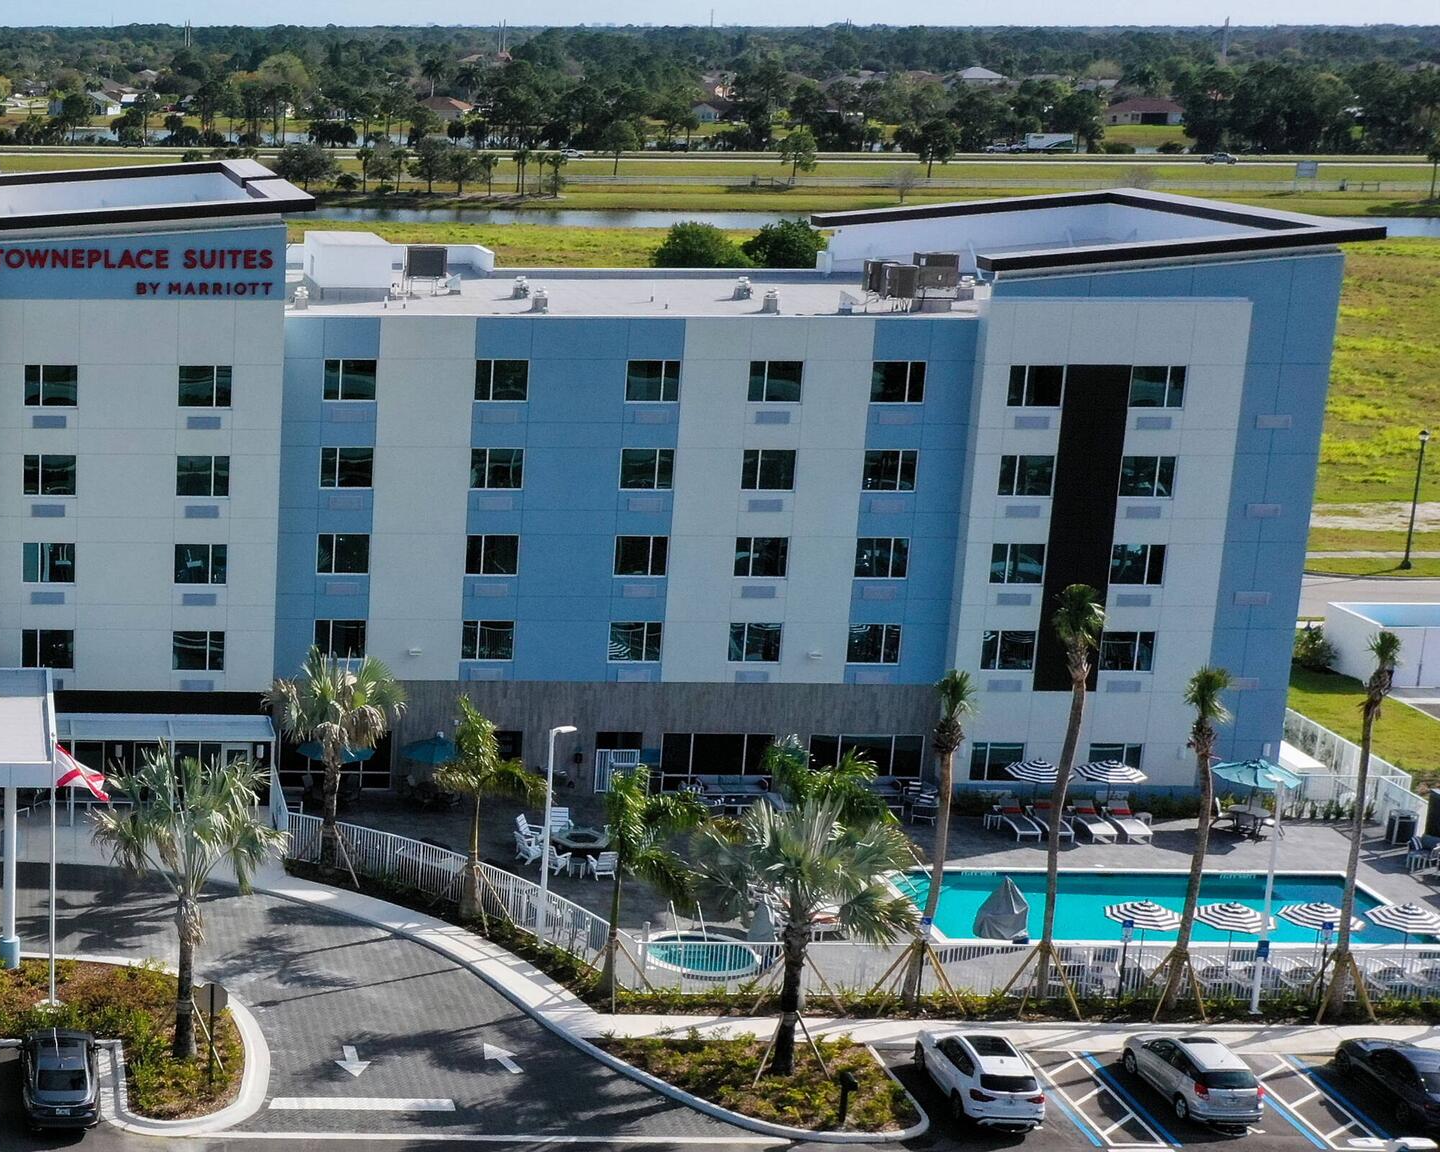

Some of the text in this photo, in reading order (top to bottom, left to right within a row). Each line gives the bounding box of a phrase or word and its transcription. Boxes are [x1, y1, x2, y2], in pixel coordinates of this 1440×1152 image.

[183, 249, 273, 269] SUITES
[136, 281, 273, 296] BY MARRIOTT
